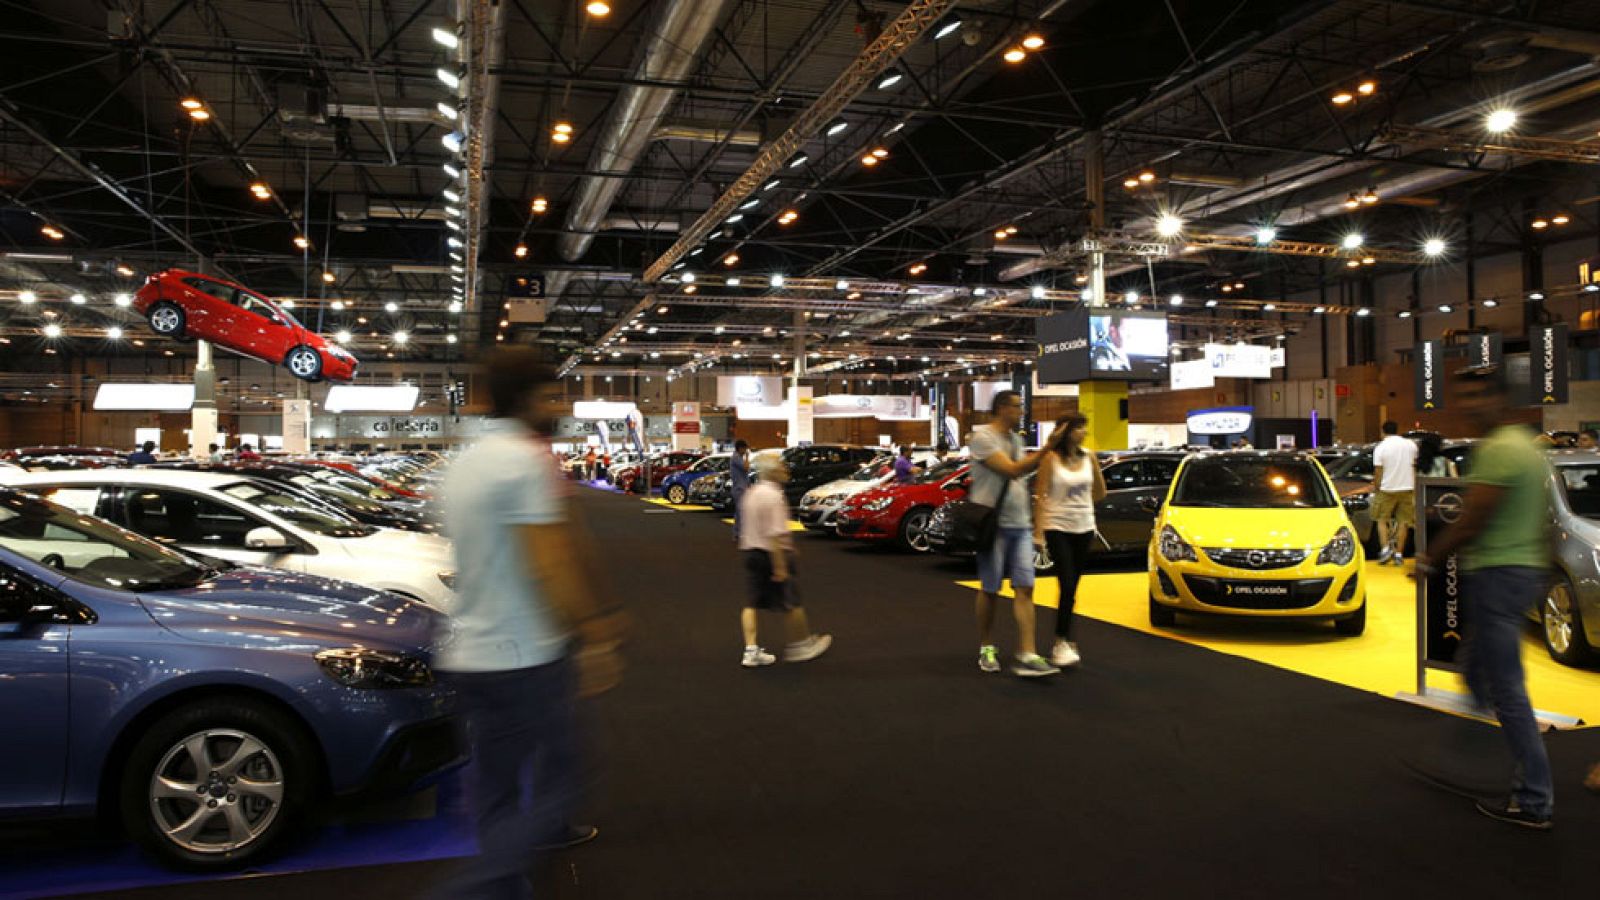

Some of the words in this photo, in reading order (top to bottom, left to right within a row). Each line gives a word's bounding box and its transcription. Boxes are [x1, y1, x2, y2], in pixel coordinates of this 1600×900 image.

[530, 280, 540, 295] 3
[1044, 343, 1059, 354] OPEL
[1481, 335, 1490, 366] CASIÓN
[1545, 370, 1553, 393] OPEL
[1446, 552, 1457, 596] OCASI
[1234, 586, 1252, 594] OPEL
[1446, 597, 1457, 628] OPEL
